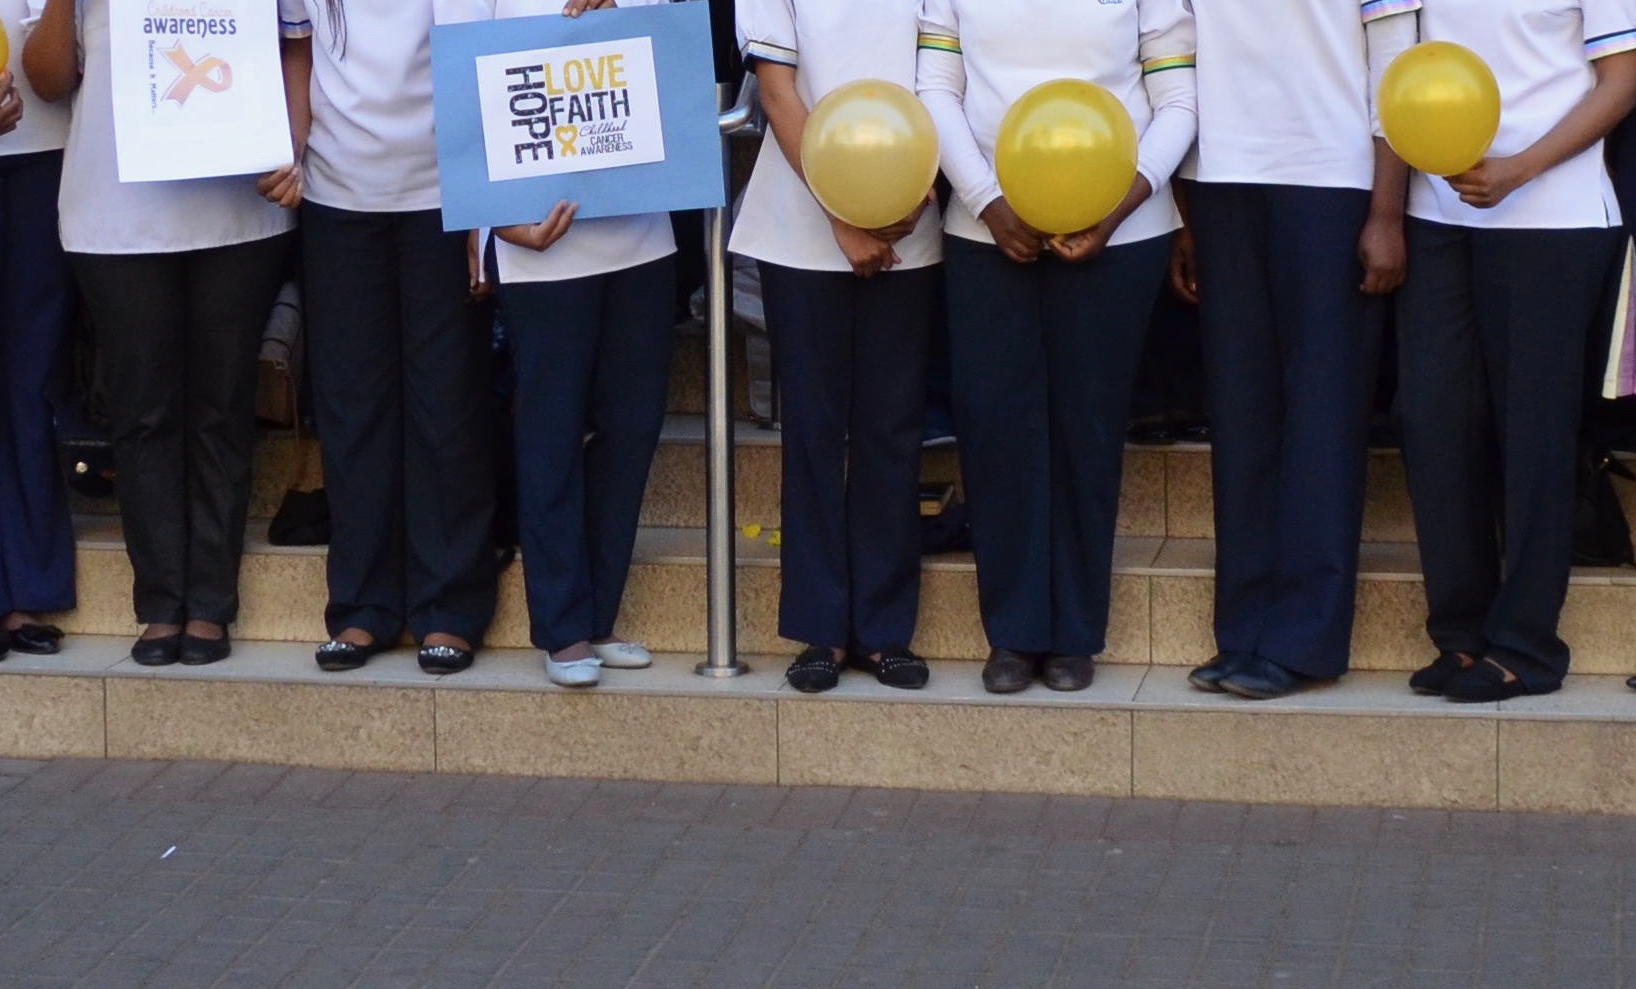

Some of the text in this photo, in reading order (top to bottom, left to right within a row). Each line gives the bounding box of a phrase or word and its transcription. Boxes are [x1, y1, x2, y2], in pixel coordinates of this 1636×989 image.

[143, 17, 237, 38] awareness
[543, 53, 628, 96] LOVE
[505, 64, 555, 164] HOPE
[548, 88, 631, 127] FAITH
[579, 119, 628, 138] Childhood
[589, 133, 624, 145] CANCER
[580, 141, 633, 156] AWARENESS
